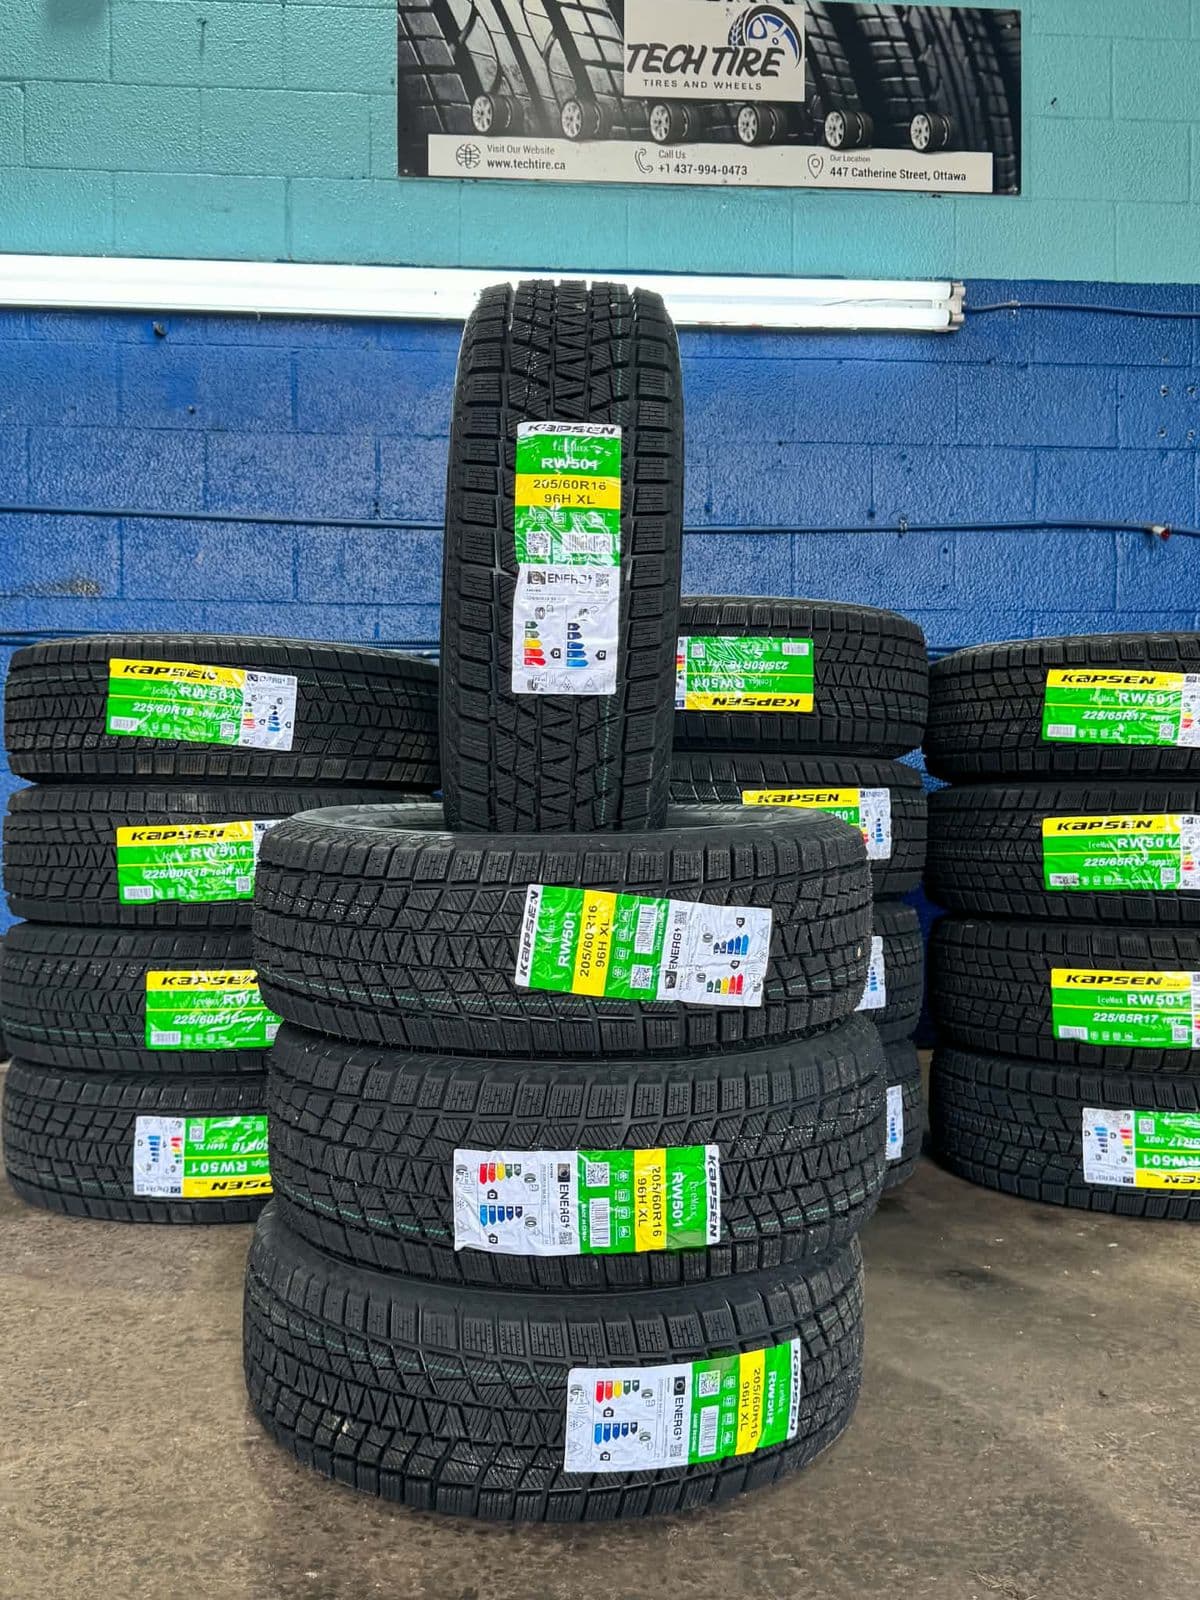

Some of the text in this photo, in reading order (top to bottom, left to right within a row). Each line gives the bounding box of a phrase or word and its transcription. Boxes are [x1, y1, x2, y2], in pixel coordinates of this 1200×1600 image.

[626, 43, 785, 77] TECH TIRE
[643, 79, 762, 91] TIRES AND WHEELS
[487, 144, 555, 155] Visit Our Website
[658, 150, 686, 160] Call Us
[487, 158, 566, 171] www.techtire.ca
[830, 154, 871, 163] Our Location
[658, 164, 748, 176] +1 437-994-0473
[829, 167, 966, 181] 447 Catherine Street, Ottawa
[533, 478, 607, 491] 205/60R16
[544, 493, 596, 506] 96H XL
[558, 911, 576, 967] RW501
[580, 904, 598, 977] 205/60R16
[596, 917, 610, 968] 96H XL
[1127, 994, 1184, 1006] RW501
[1092, 1012, 1159, 1024] 225/65R17
[191, 1161, 247, 1173] RW501
[638, 1178, 648, 1227] 96H XL
[651, 1166, 662, 1237] 205/60R16
[672, 1171, 684, 1227] RW501
[740, 1381, 750, 1432] 96H XL
[751, 1367, 762, 1438] 205/60R16
[673, 1396, 684, 1436] ENERG
